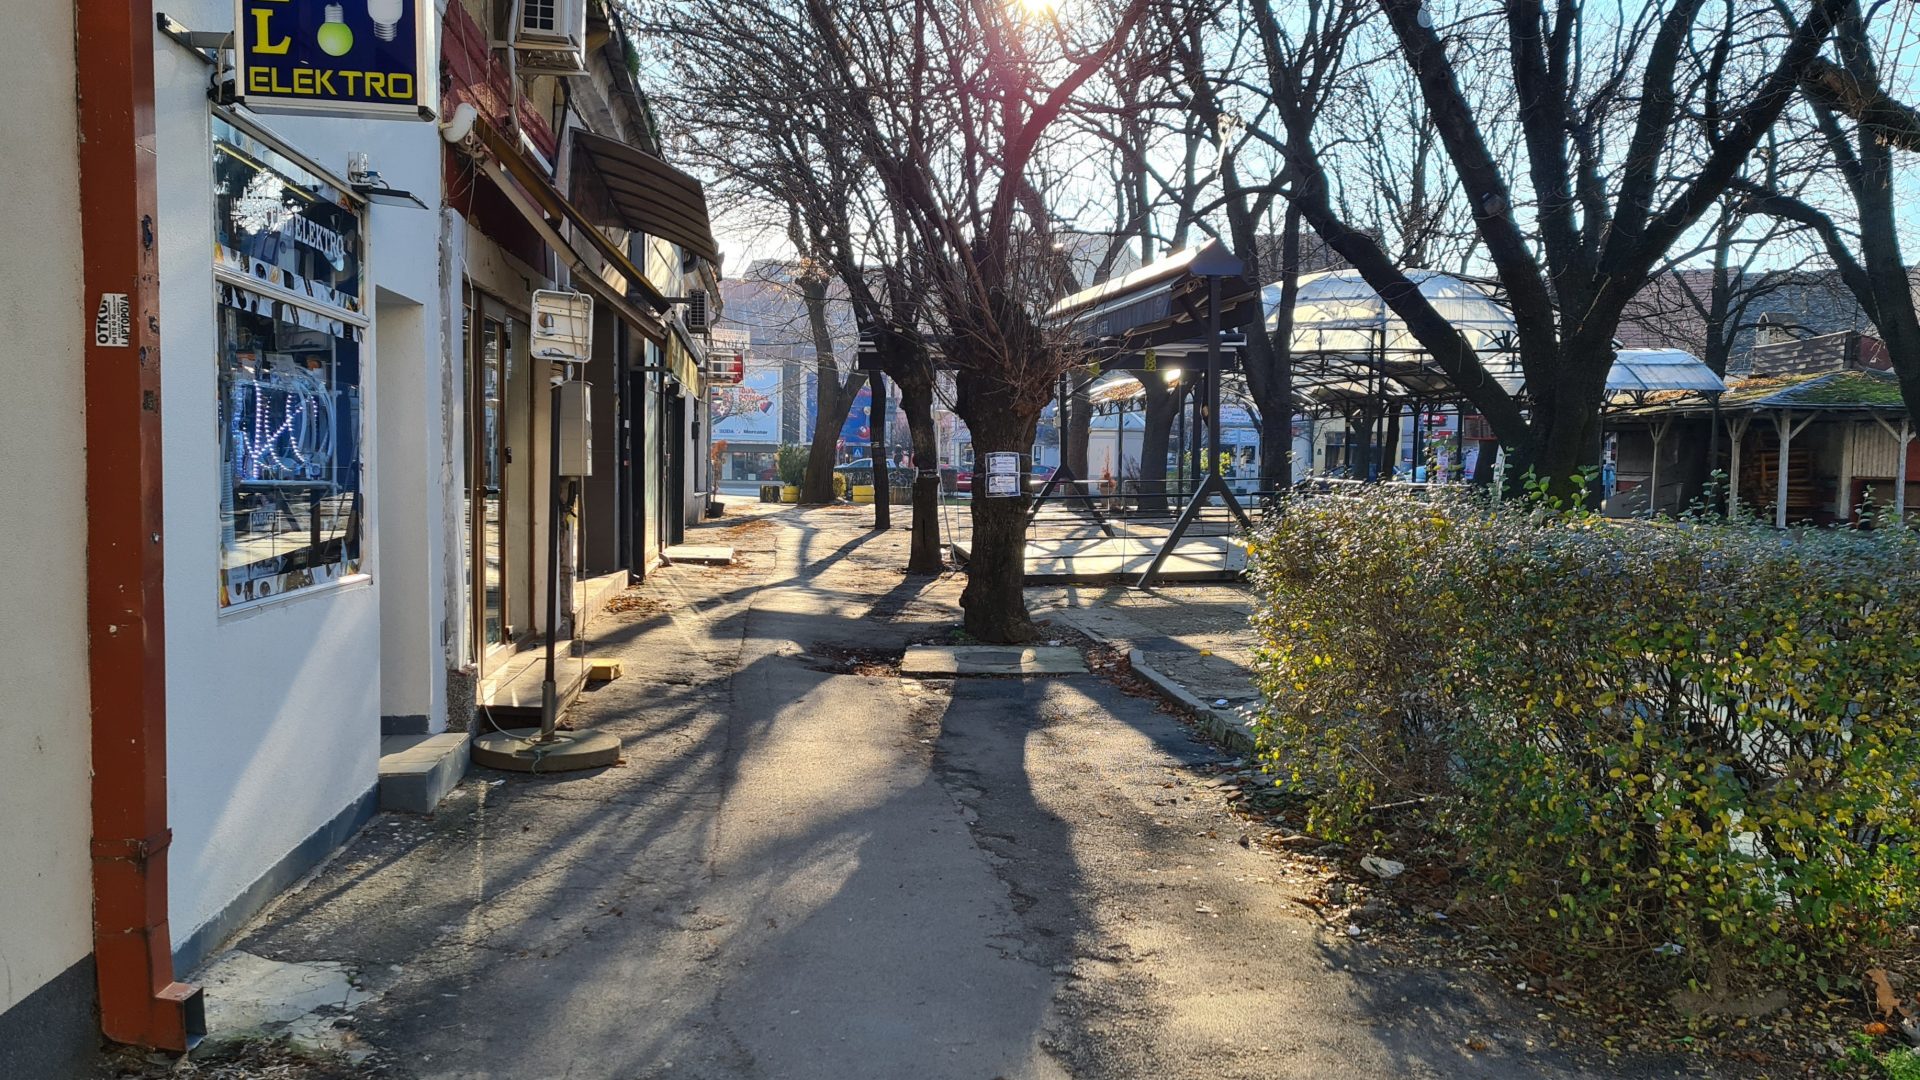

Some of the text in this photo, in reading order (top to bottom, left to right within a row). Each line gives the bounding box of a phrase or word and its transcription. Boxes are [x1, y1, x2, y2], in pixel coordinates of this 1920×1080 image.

[251, 0, 292, 54] L
[249, 66, 413, 99] ELEKTRO
[294, 213, 346, 258] ELEKTRO
[97, 300, 108, 344] OTKU
